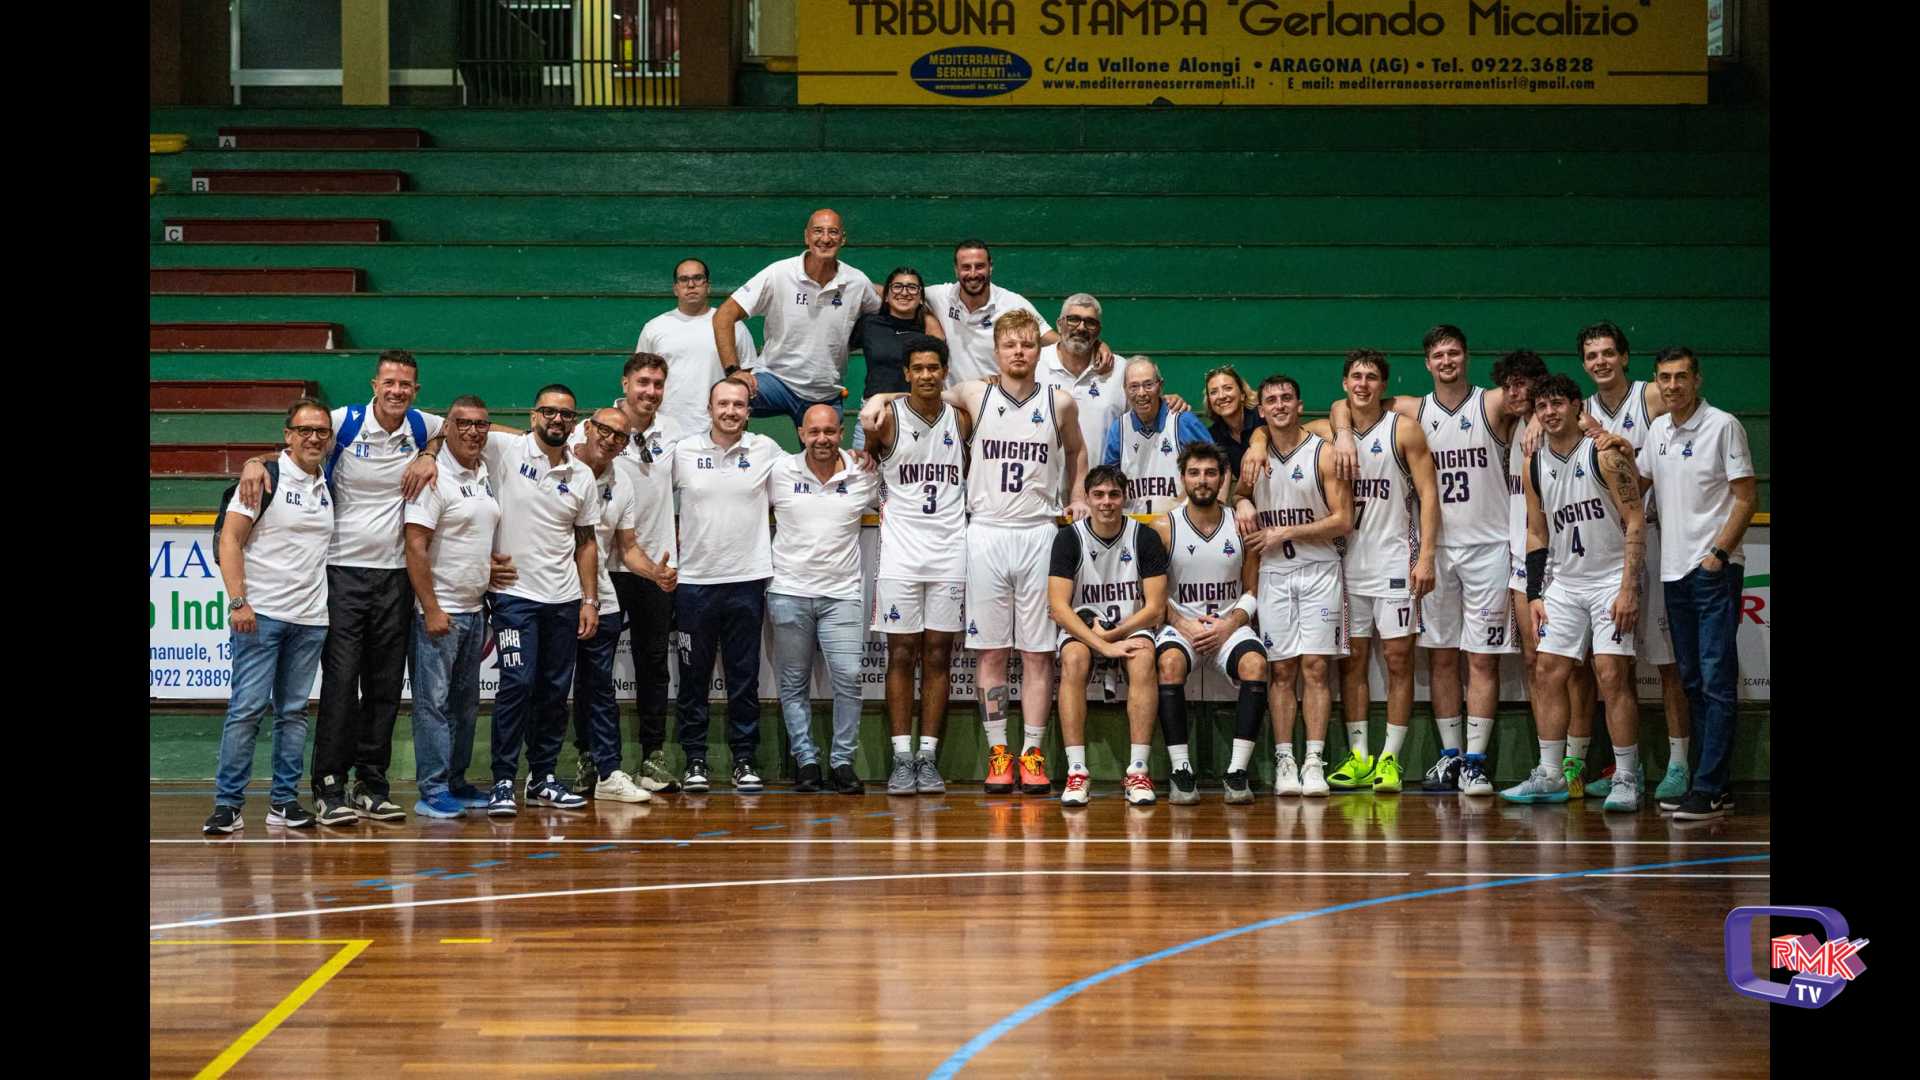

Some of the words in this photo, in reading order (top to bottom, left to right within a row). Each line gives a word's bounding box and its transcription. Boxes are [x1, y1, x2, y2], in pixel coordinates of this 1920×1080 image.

[849, 0, 1015, 35] TRIBUNA
[1040, 0, 1208, 35] STAMPA
[928, 54, 1012, 65] MEDITERRANEA
[1044, 58, 1088, 74] C/da
[1098, 57, 1169, 72] Vallone
[1180, 57, 1239, 76] Alongi
[1270, 58, 1361, 72] ARAGONA
[1370, 58, 1408, 74] (AG)
[1432, 57, 1463, 72] Tel.
[1471, 58, 1593, 72] 0922.36828
[936, 66, 1005, 78] SERRAMENTI
[1042, 76, 1255, 89] www.mediterraneaserramenti.it
[196, 181, 206, 192] B
[169, 229, 180, 241] C
[697, 457, 714, 469] G.G.
[982, 439, 1049, 464] KNIGHTS
[1431, 447, 1488, 470] NIGHTS
[900, 463, 960, 486] KNIGHTS
[1001, 462, 1024, 493] 13
[1127, 476, 1178, 500] RIBERA
[1353, 479, 1391, 500] GHTS
[1441, 471, 1470, 503] 23
[923, 484, 936, 515] 3
[1146, 499, 1153, 515] 1
[1258, 508, 1315, 530] NIGHTS
[1354, 501, 1367, 530] 7
[1572, 526, 1585, 557] 4
[1178, 580, 1238, 603] KNIGHTS
[171, 591, 232, 630] Ind
[1397, 607, 1410, 628] 17
[1738, 595, 1766, 625] R
[1487, 626, 1505, 646] 23
